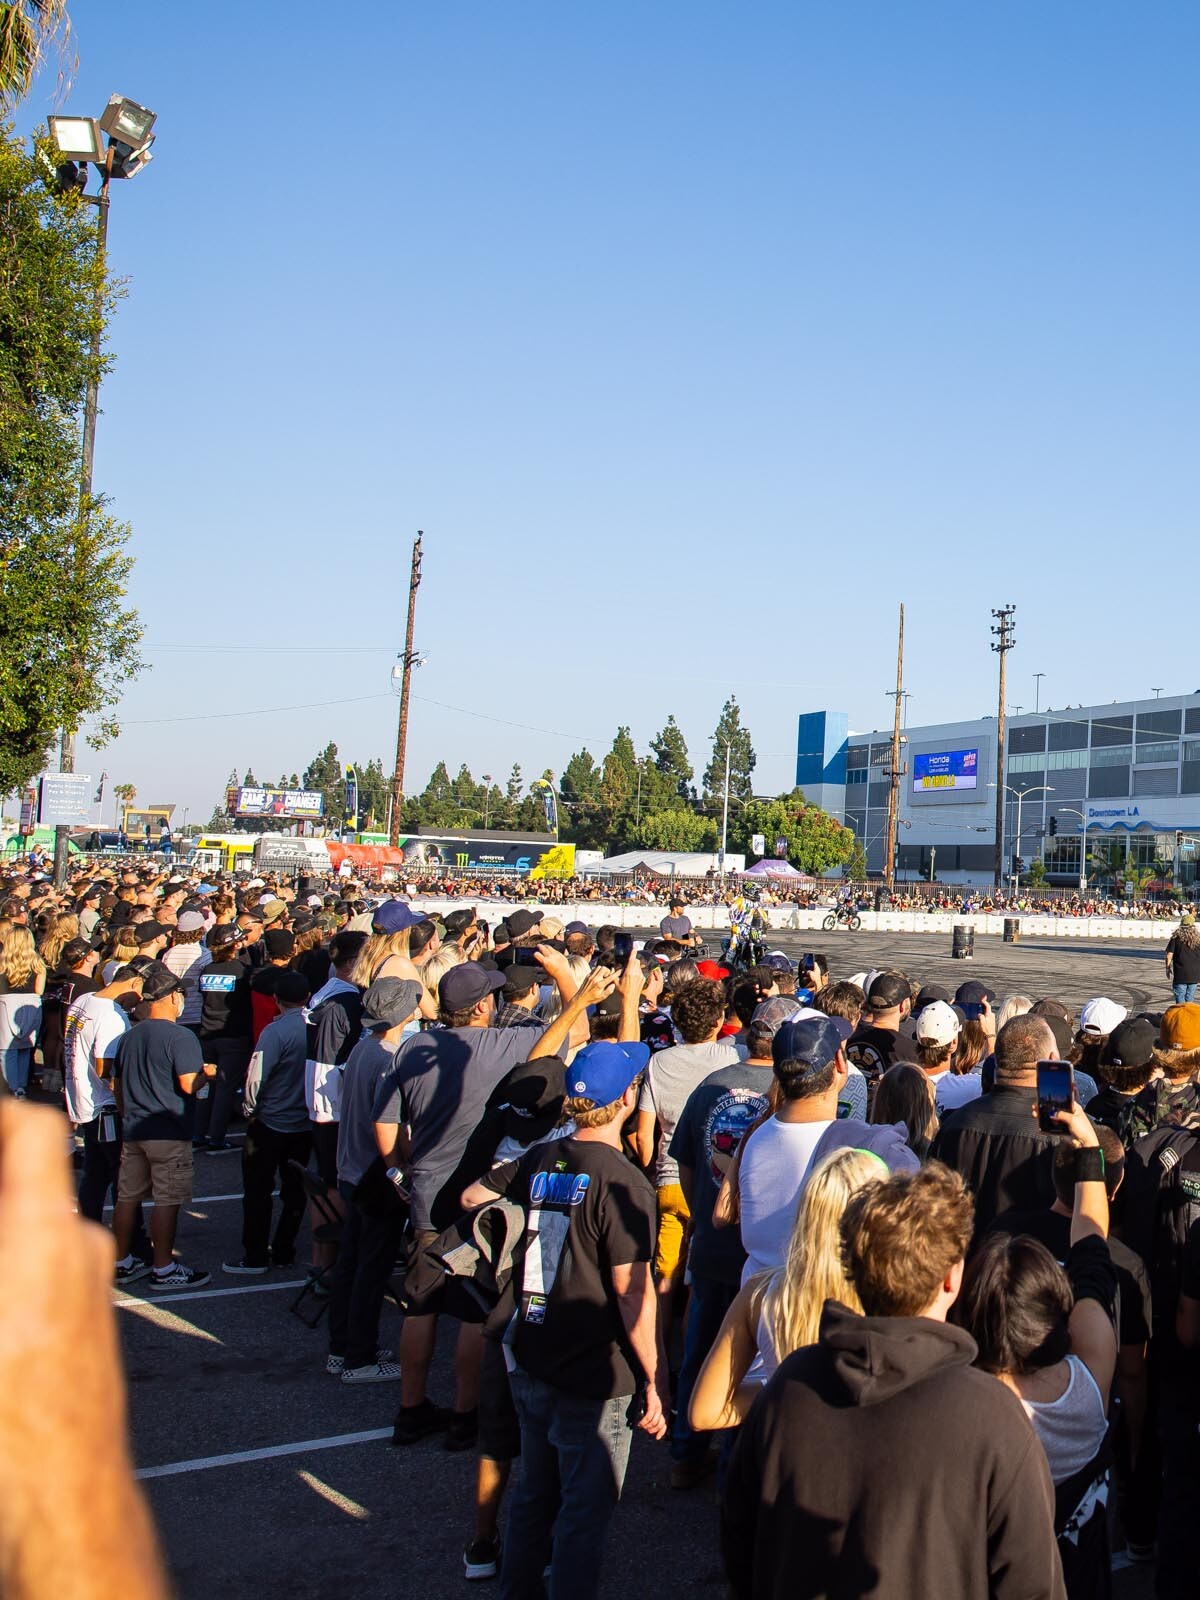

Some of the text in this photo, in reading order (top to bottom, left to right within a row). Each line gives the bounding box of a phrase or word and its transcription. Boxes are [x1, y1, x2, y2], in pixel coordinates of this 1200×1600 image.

[929, 756, 950, 764] Honda
[241, 792, 321, 809] GAME CHANGER
[1089, 806, 1139, 817] Downtown LA
[712, 1096, 750, 1115] VETERANS
[750, 1098, 765, 1111] DAY
